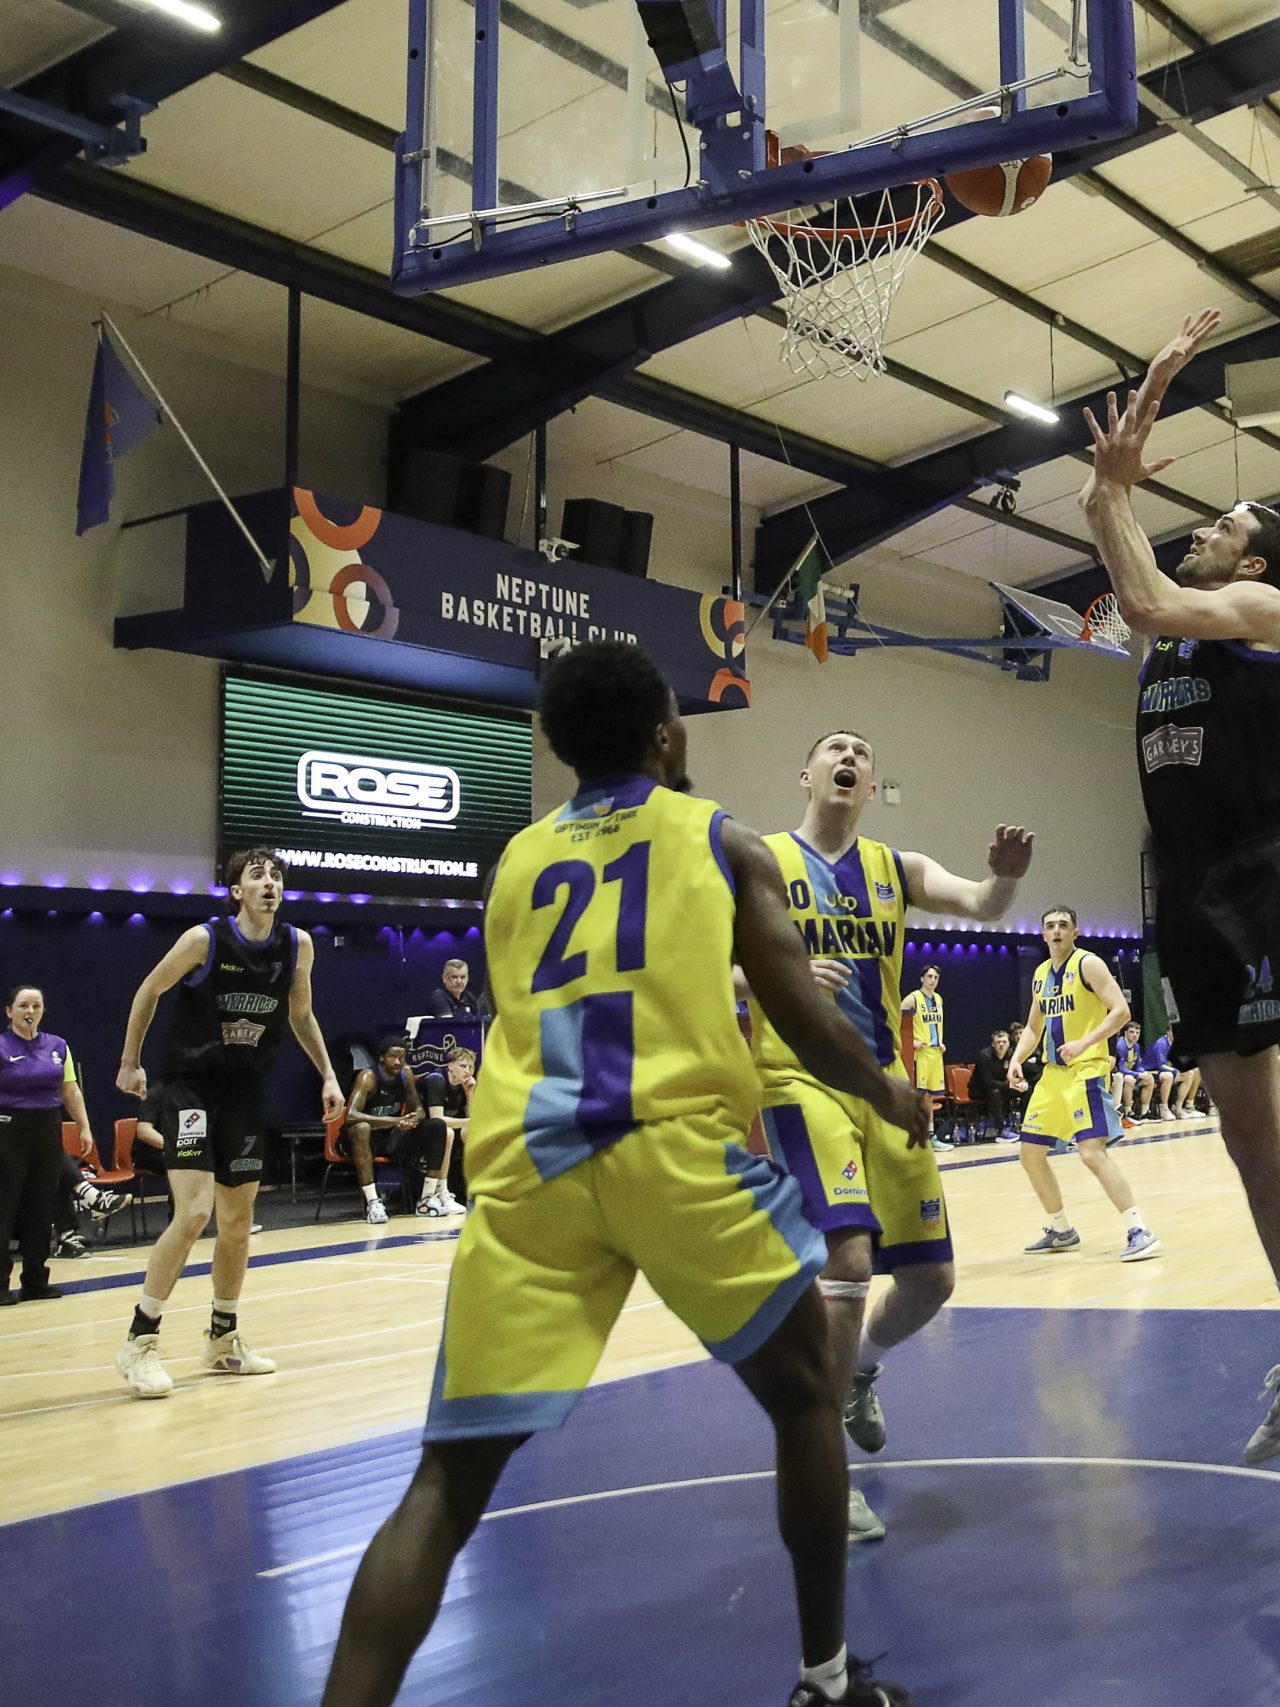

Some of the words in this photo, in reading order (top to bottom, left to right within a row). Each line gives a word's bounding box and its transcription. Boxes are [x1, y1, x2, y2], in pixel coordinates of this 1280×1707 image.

[496, 573, 590, 619] NEPTUNE
[441, 591, 582, 646] BASKETBALL
[310, 761, 450, 810] ROSE
[340, 811, 422, 830] CONSTRUCTION
[570, 832, 590, 843] EST
[531, 840, 652, 995] 21
[270, 961, 282, 984] 7
[412, 1050, 444, 1062] NEPTUNE
[240, 1135, 257, 1156] 7
